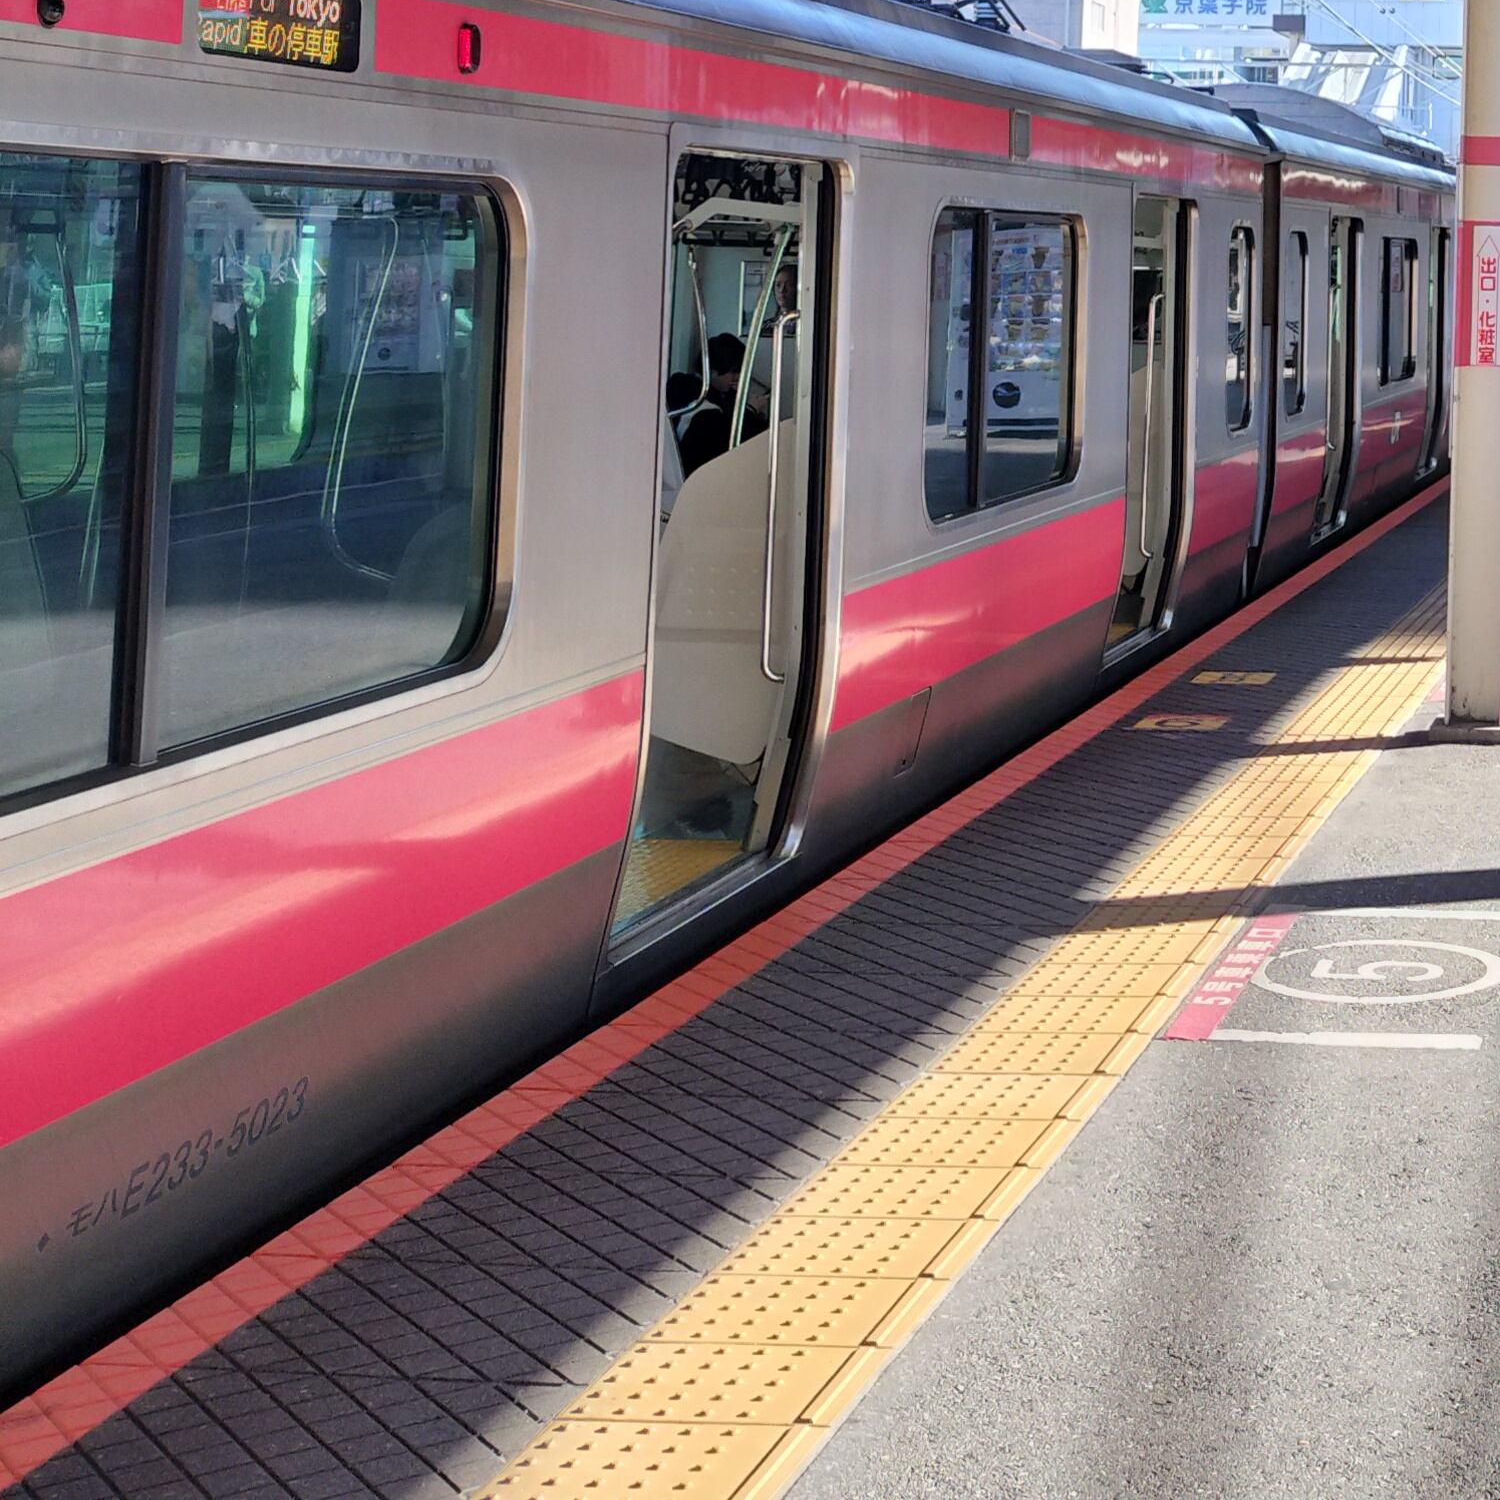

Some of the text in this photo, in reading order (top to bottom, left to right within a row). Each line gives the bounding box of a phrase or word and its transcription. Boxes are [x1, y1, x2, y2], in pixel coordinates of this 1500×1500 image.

[244, 16, 340, 65] 車の停車駅
[1478, 257, 1497, 364] 出口・化粧室
[1310, 957, 1444, 982] 5
[66, 1075, 309, 1239] モハE233-5023
